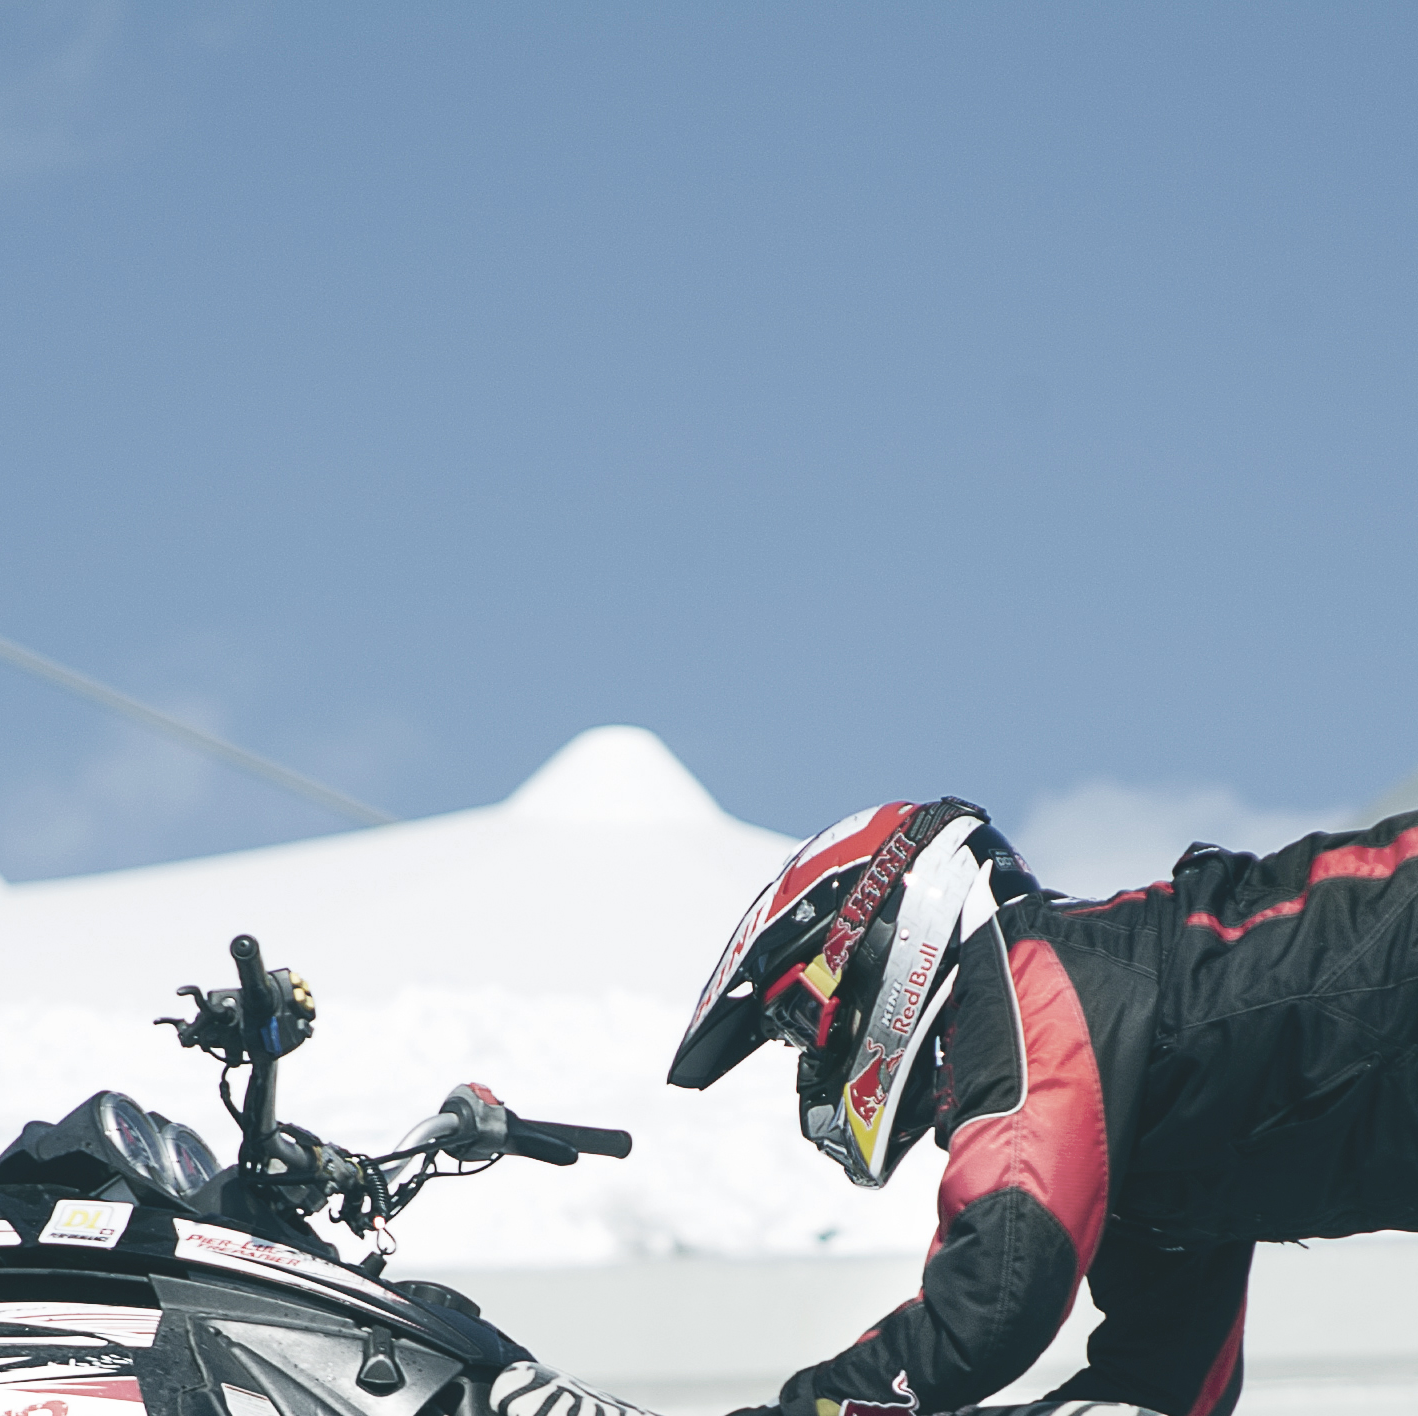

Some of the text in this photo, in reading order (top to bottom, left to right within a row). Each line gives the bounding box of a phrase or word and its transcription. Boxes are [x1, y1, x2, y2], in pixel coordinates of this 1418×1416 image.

[848, 832, 916, 919] KINI
[881, 979, 903, 1027] KINI
[891, 942, 939, 1035] Red Bull
